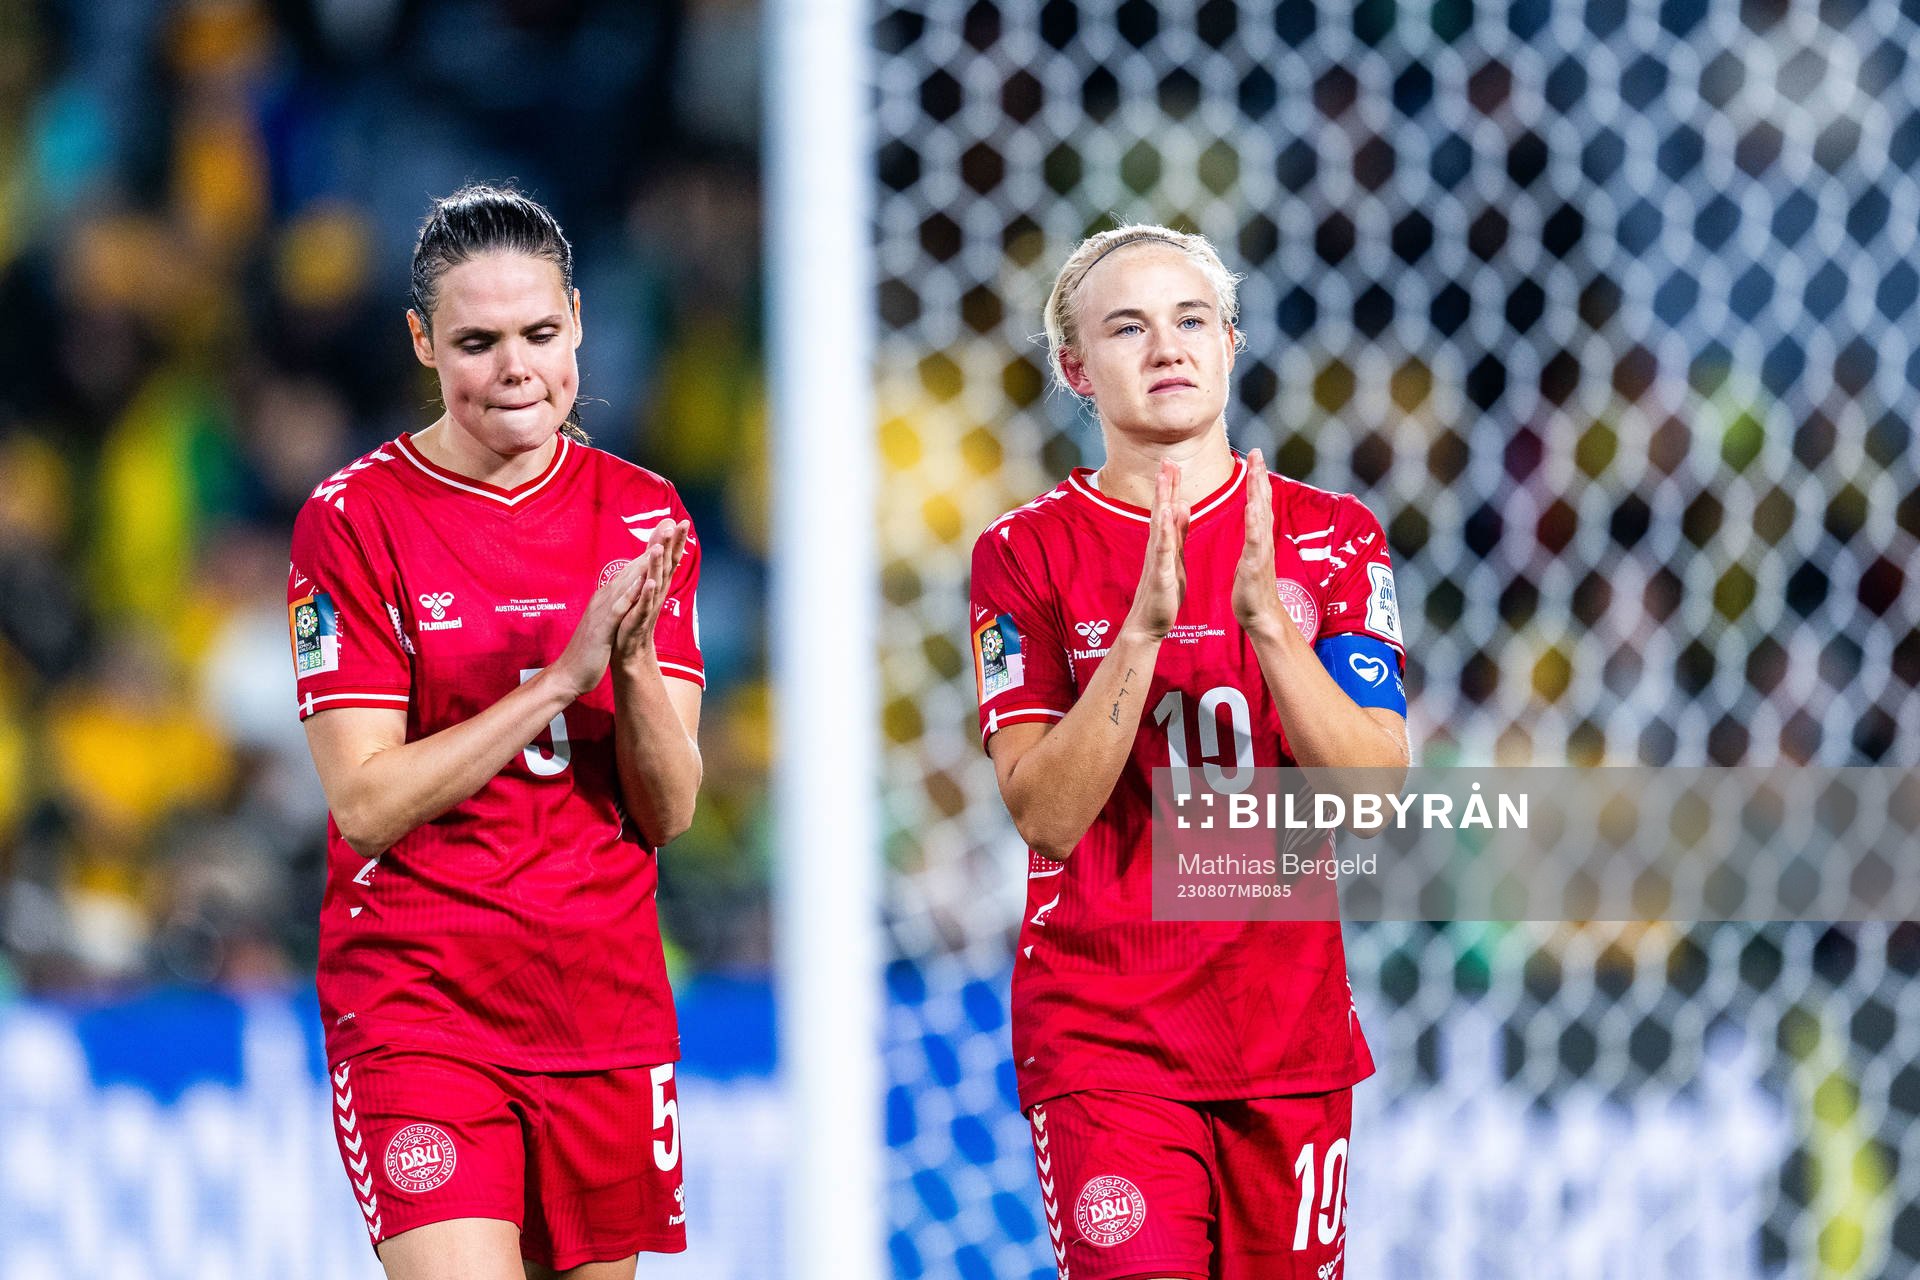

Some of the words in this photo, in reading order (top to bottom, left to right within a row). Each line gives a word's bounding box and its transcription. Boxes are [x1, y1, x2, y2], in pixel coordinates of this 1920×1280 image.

[494, 604, 528, 612] AUSTRALIA
[536, 602, 567, 611] DENMARK
[419, 617, 462, 631] hummel
[1165, 630, 1186, 639] RALIA
[1195, 629, 1225, 638] DENMARK
[1074, 648, 1110, 660] humm
[1153, 686, 1255, 801] 10
[650, 1062, 680, 1172] 5
[388, 1151, 409, 1188] DANSK
[398, 1144, 442, 1171] DBU
[441, 1140, 454, 1177] UNION
[413, 1177, 441, 1190] 1889
[1293, 1137, 1349, 1251] 10
[1078, 1205, 1099, 1241] DANSK
[1088, 1196, 1131, 1224] DBU
[1130, 1192, 1143, 1229] UNION
[1103, 1229, 1130, 1243] 1889
